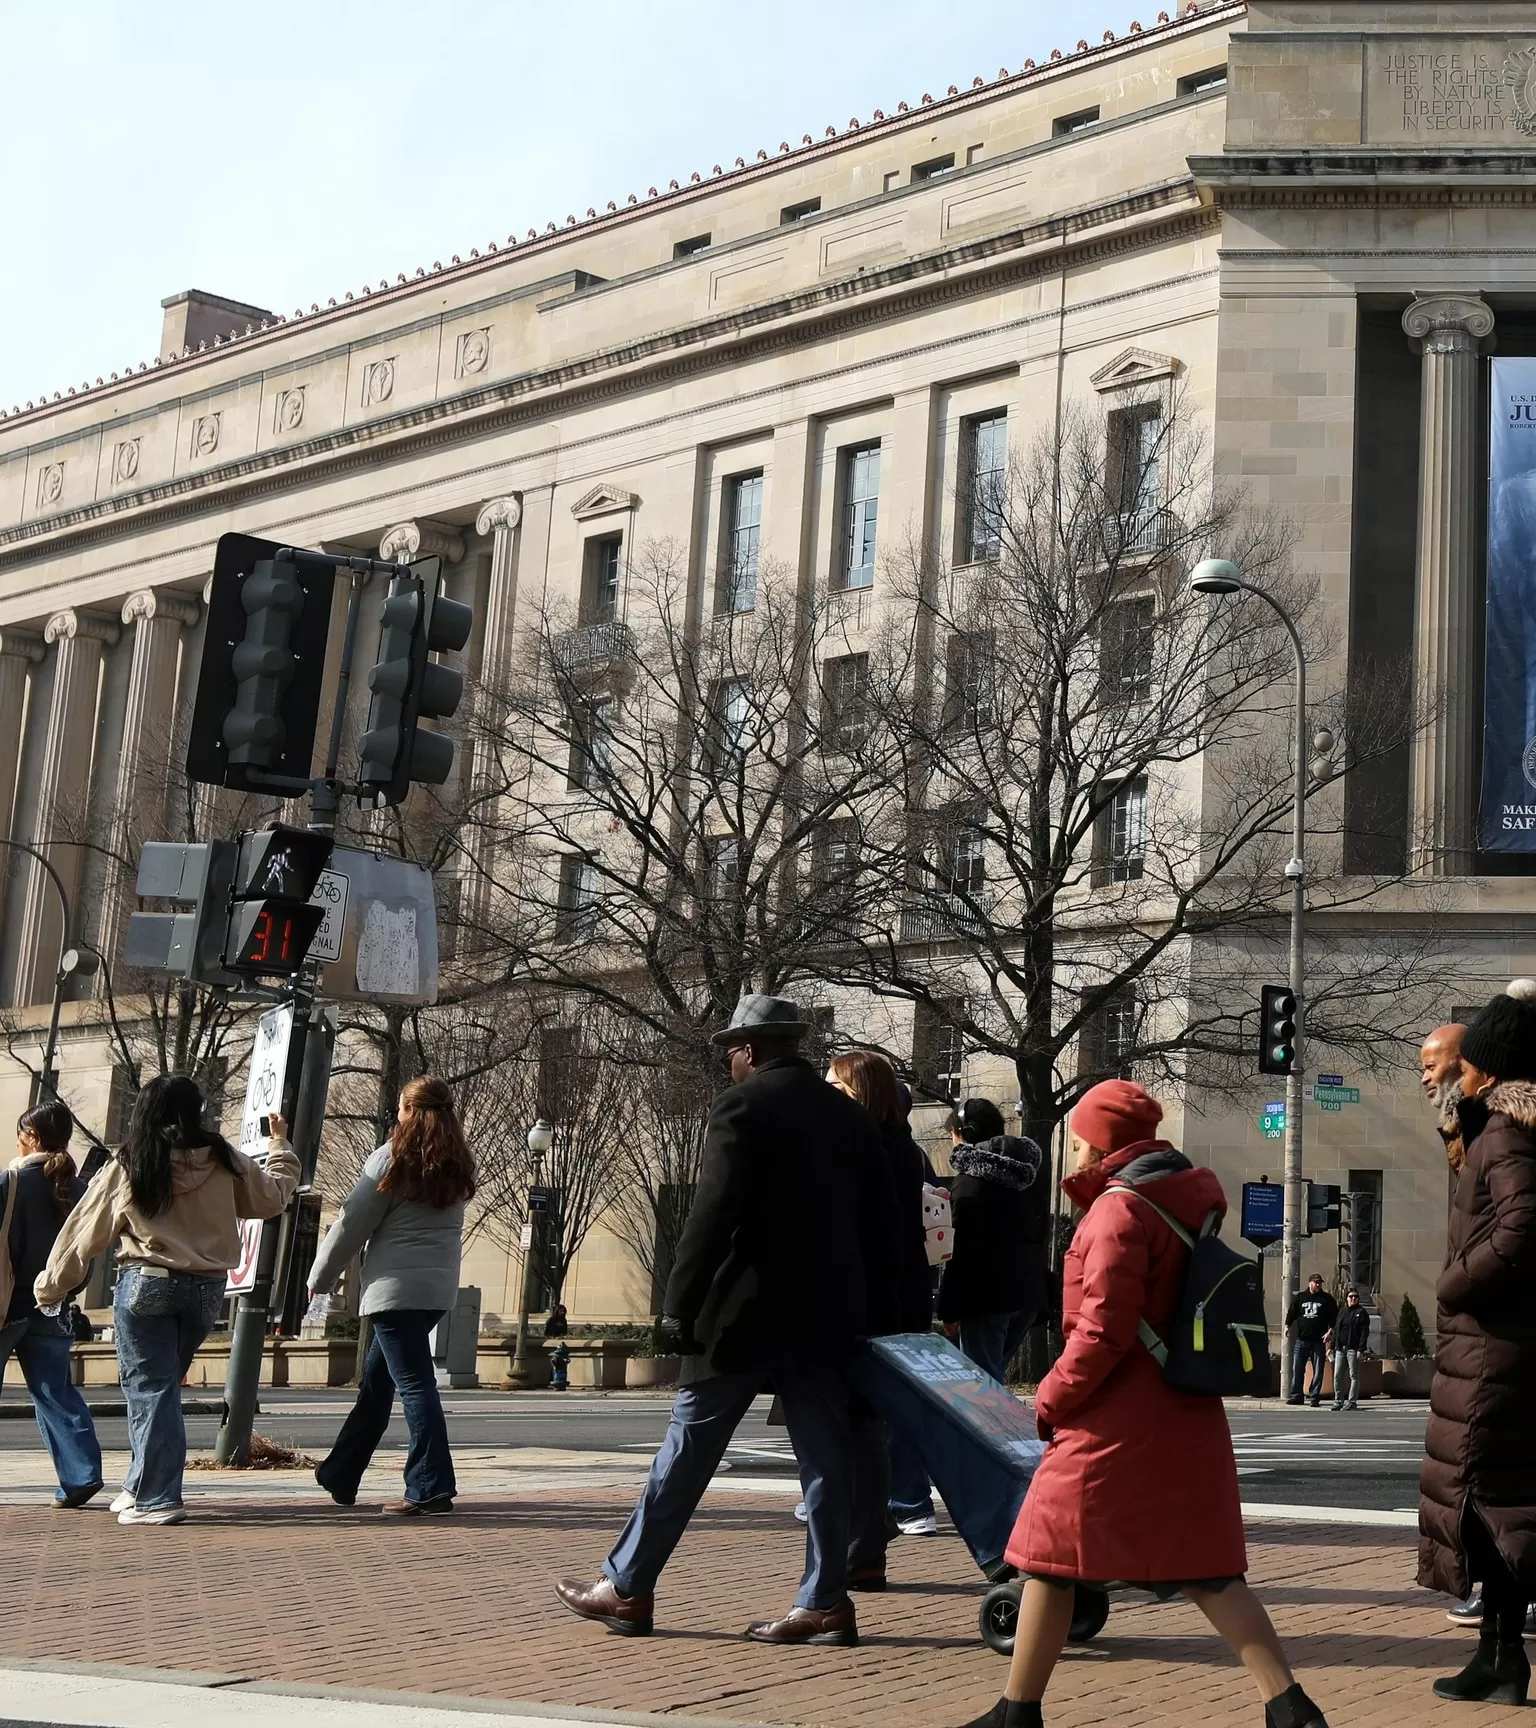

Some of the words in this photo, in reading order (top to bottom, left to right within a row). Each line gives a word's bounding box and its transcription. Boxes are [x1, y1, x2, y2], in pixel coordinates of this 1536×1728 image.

[1383, 54, 1461, 69] JUSTICE
[1473, 54, 1488, 69] IS
[1384, 70, 1419, 84] THE
[1432, 69, 1499, 84] RIGHTS
[1403, 85, 1424, 99] BY
[1433, 85, 1505, 99] NATURE
[1403, 100, 1477, 115] LIBERTY
[1487, 100, 1502, 115] IS
[1402, 116, 1419, 130] IN
[1426, 115, 1509, 130] SECURITY
[1510, 395, 1529, 403] U.S.
[318, 921, 330, 934] ED
[250, 911, 291, 961] 31
[1315, 1086, 1350, 1101] Pennsylvania
[1322, 1102, 1340, 1110] 900
[1264, 1117, 1272, 1129] 9
[1267, 1130, 1281, 1138] 200
[895, 1349, 964, 1371] Life
